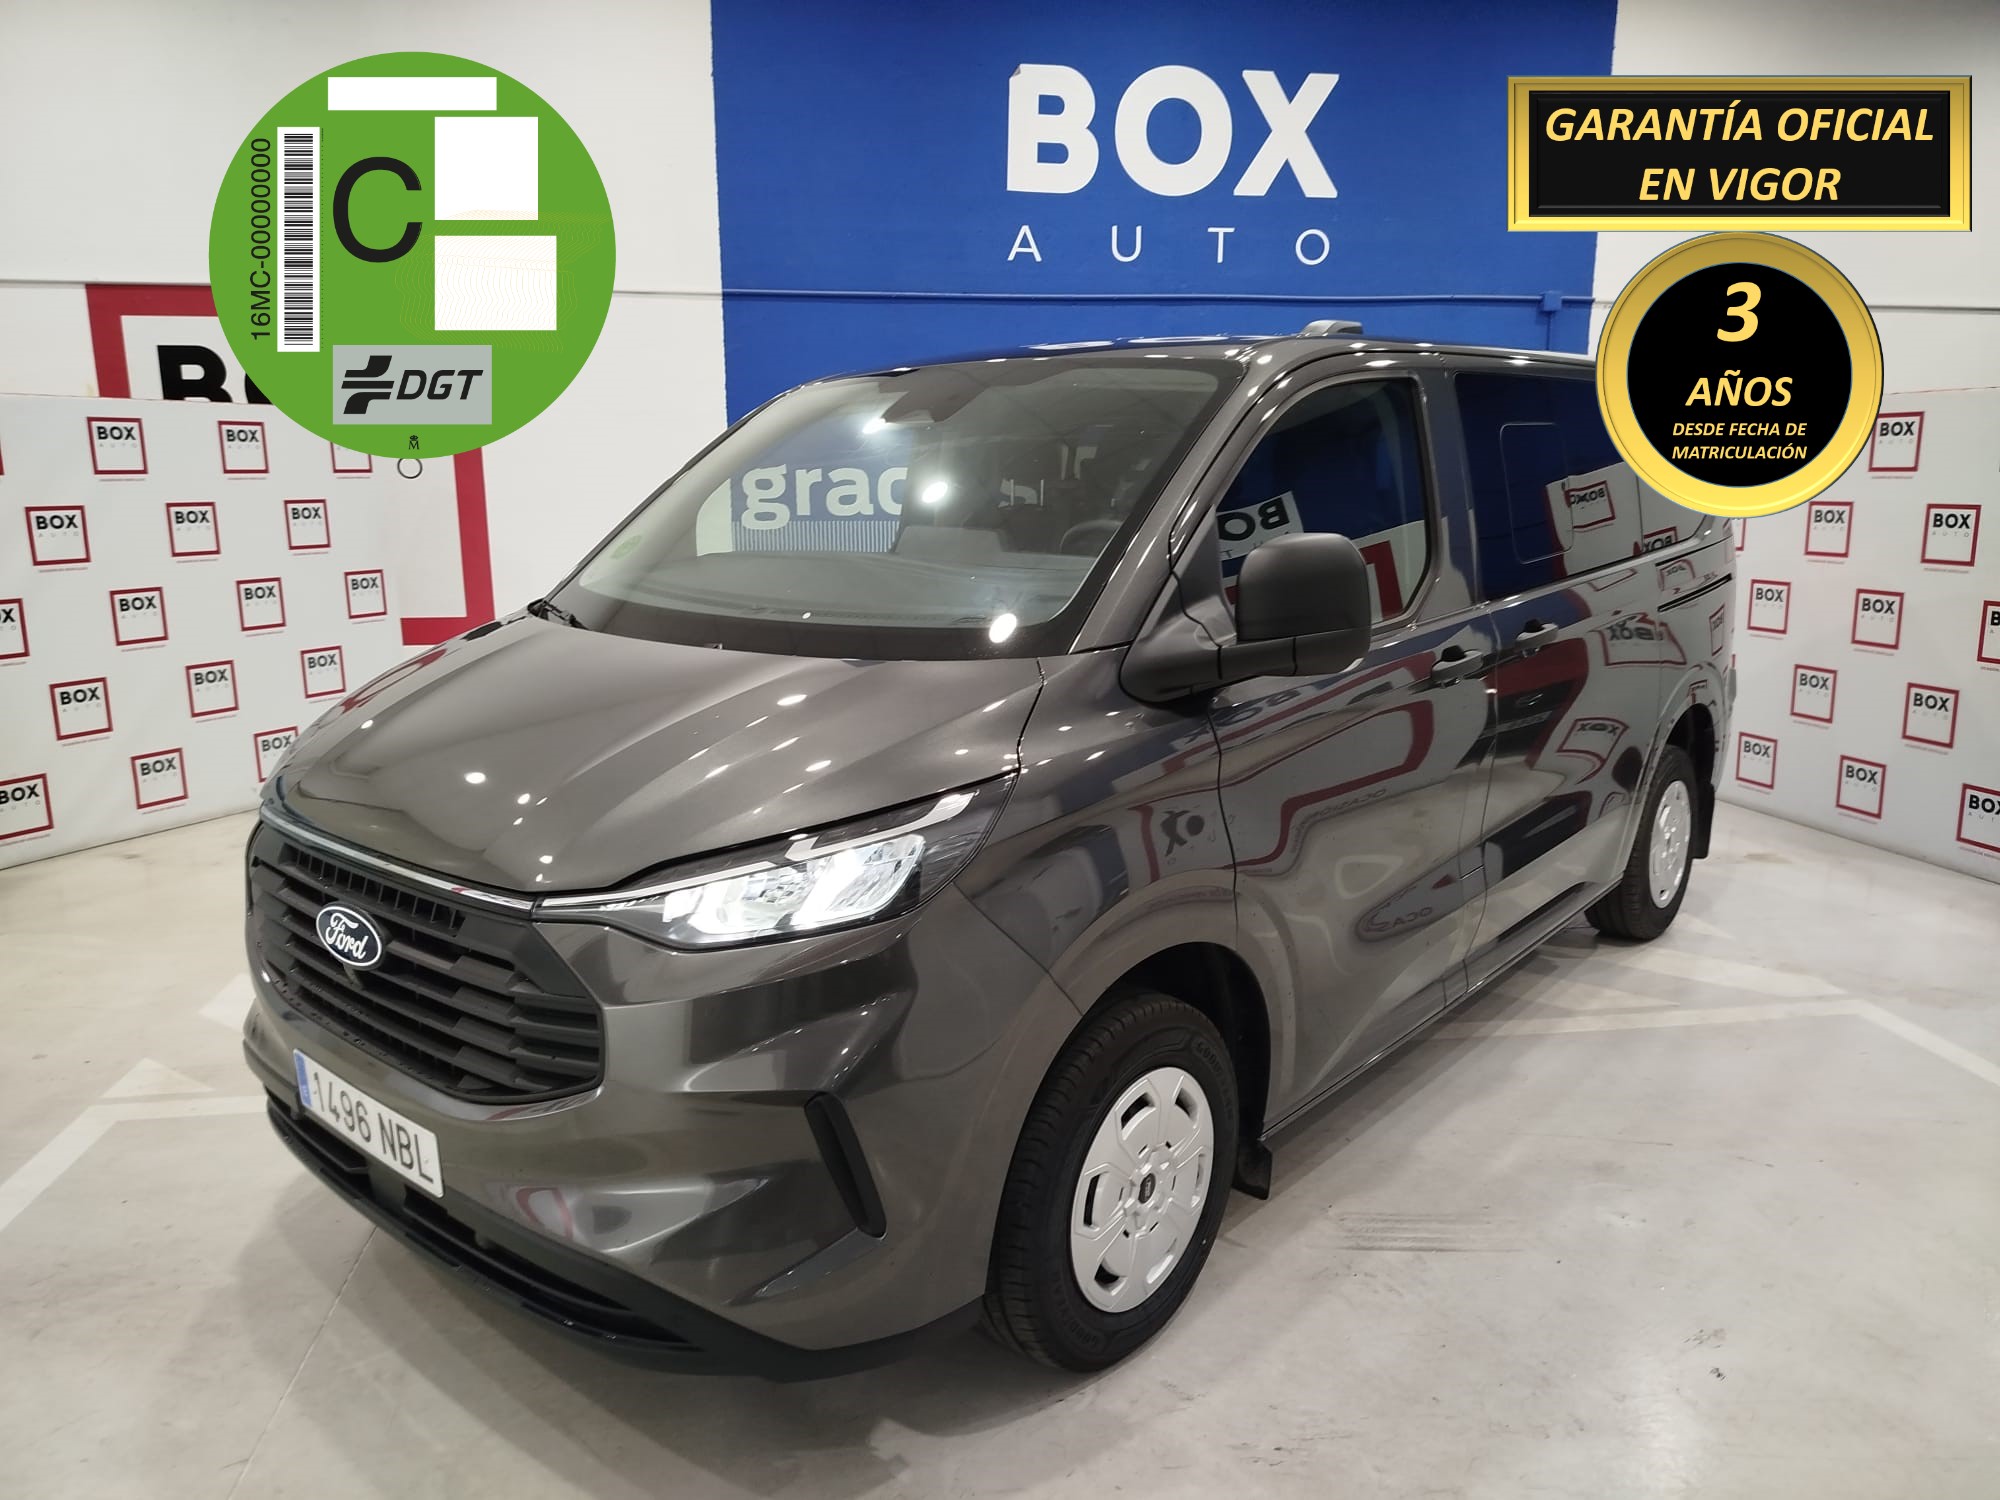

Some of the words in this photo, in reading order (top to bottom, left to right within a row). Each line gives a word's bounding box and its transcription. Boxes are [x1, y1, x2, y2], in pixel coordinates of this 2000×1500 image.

[1007, 63, 1339, 198] BOX
[1007, 225, 1330, 265] AUTO
[97, 426, 136, 440] BOX
[226, 429, 259, 442] BOX
[1880, 421, 1915, 436] BOX
[174, 510, 210, 524] BOX
[291, 507, 322, 519] BOX
[1814, 510, 1846, 523] BOX
[1933, 513, 1971, 529] BOX
[35, 514, 78, 530] BOX
[351, 577, 379, 590] BOX
[244, 586, 276, 600] BOX
[1755, 588, 1784, 602] BOX
[119, 596, 157, 612] BOX
[1862, 598, 1895, 614] BOX
[307, 654, 337, 668] BOX
[194, 669, 228, 685] BOX
[1799, 674, 1830, 690] BOX
[60, 687, 100, 705] BOX
[1913, 693, 1950, 712] BOX
[261, 735, 292, 752] BOX
[1743, 741, 1771, 758] BOX
[140, 757, 177, 776] BOX
[1846, 765, 1878, 784] BOX
[0, 784, 39, 805] BOX
[326, 912, 369, 960] Ford
[313, 1071, 372, 1143] 1496
[378, 1112, 434, 1184] NBL
